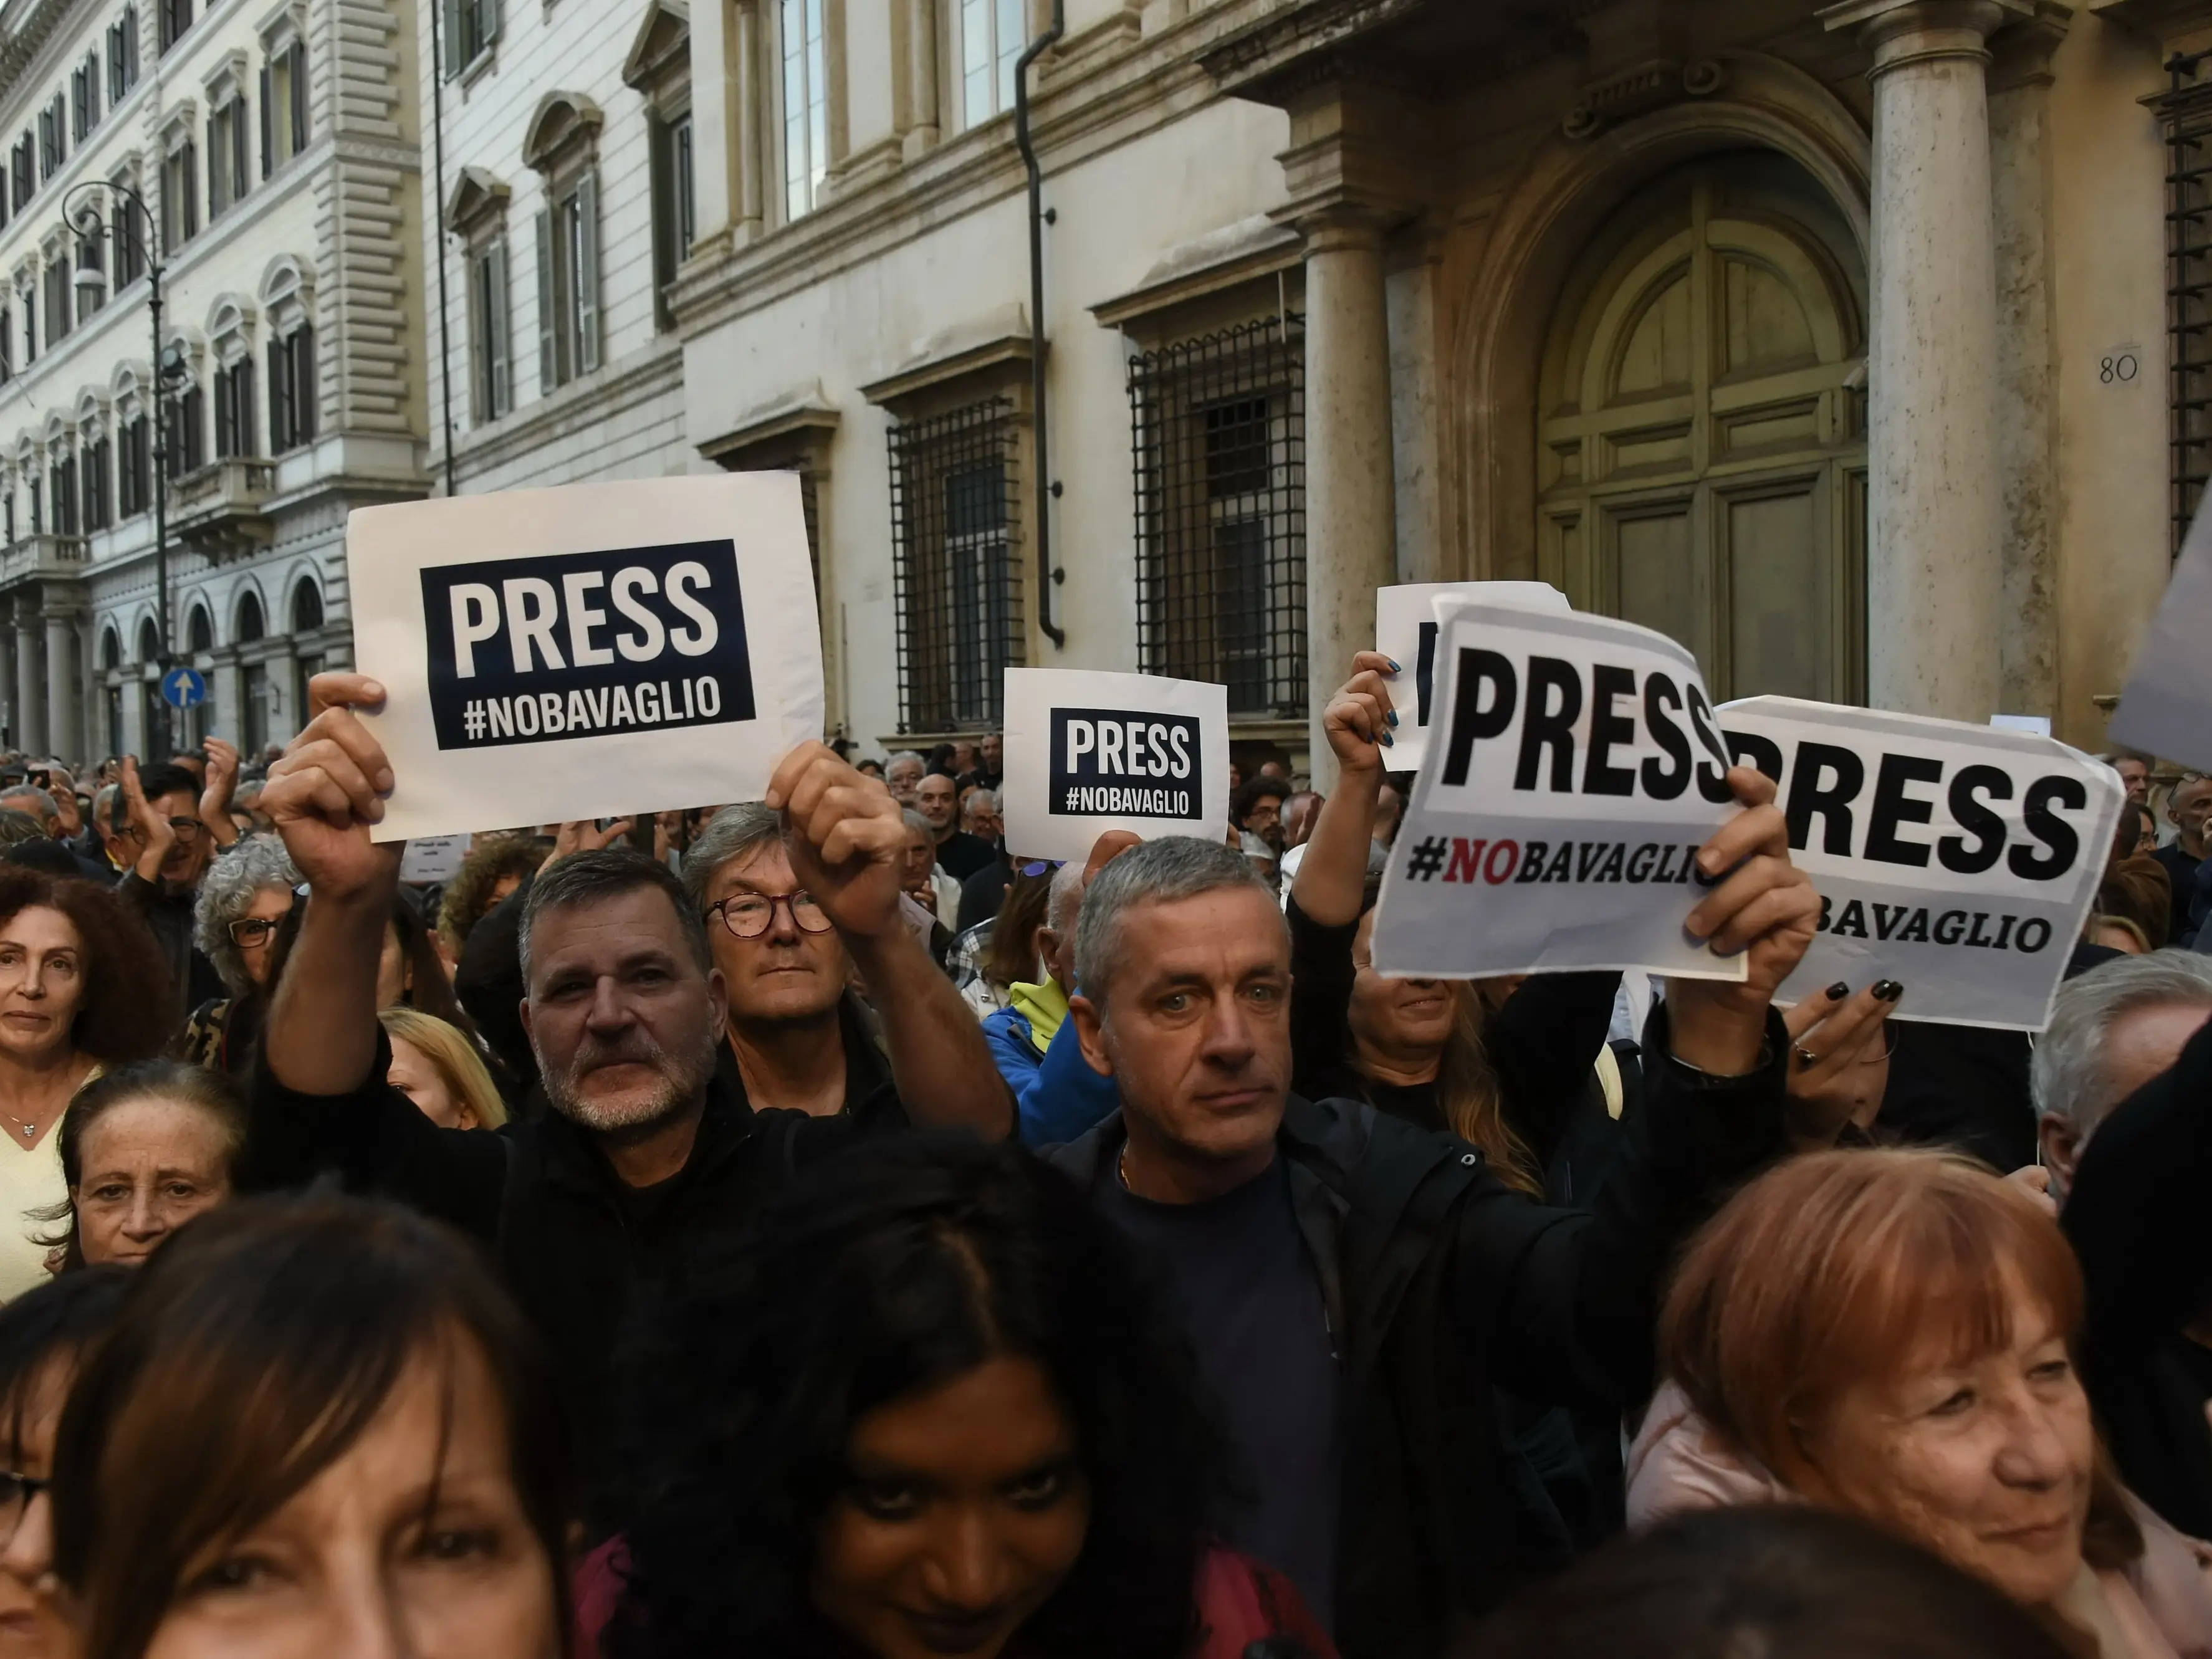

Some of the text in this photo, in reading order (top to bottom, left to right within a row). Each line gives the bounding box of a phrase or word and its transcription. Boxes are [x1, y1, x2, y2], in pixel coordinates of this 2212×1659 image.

[2100, 355, 2138, 383] 80
[448, 561, 719, 679] PRESS
[463, 676, 721, 740] #NOBAVAGLIO
[1440, 646, 1735, 803] PRESS
[1066, 719, 1190, 779] PRESS
[1066, 786, 1190, 815] #NOBAVAGLIO
